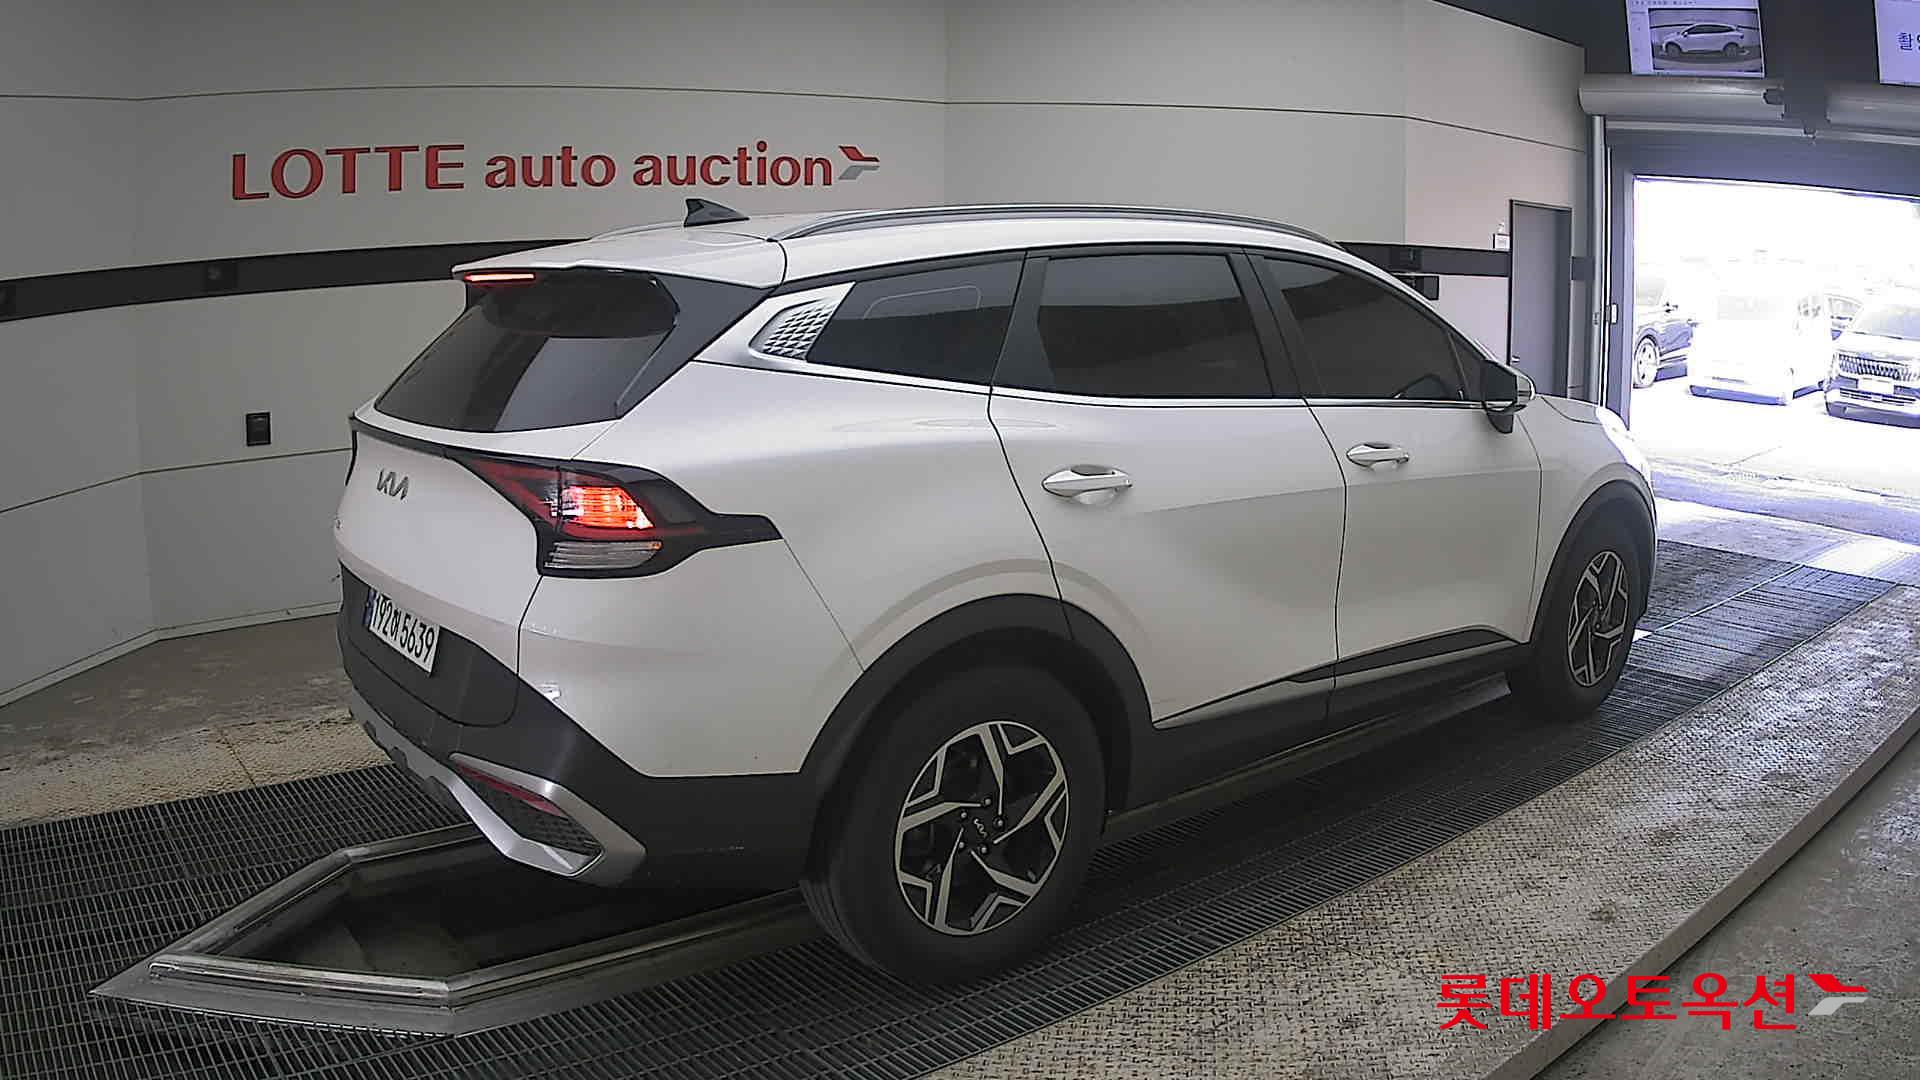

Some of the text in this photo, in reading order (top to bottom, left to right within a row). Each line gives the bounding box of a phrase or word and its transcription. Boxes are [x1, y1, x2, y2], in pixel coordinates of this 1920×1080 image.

[232, 141, 832, 200] LOTTE auto auction
[376, 469, 409, 500] KIA
[400, 613, 435, 663] 5639
